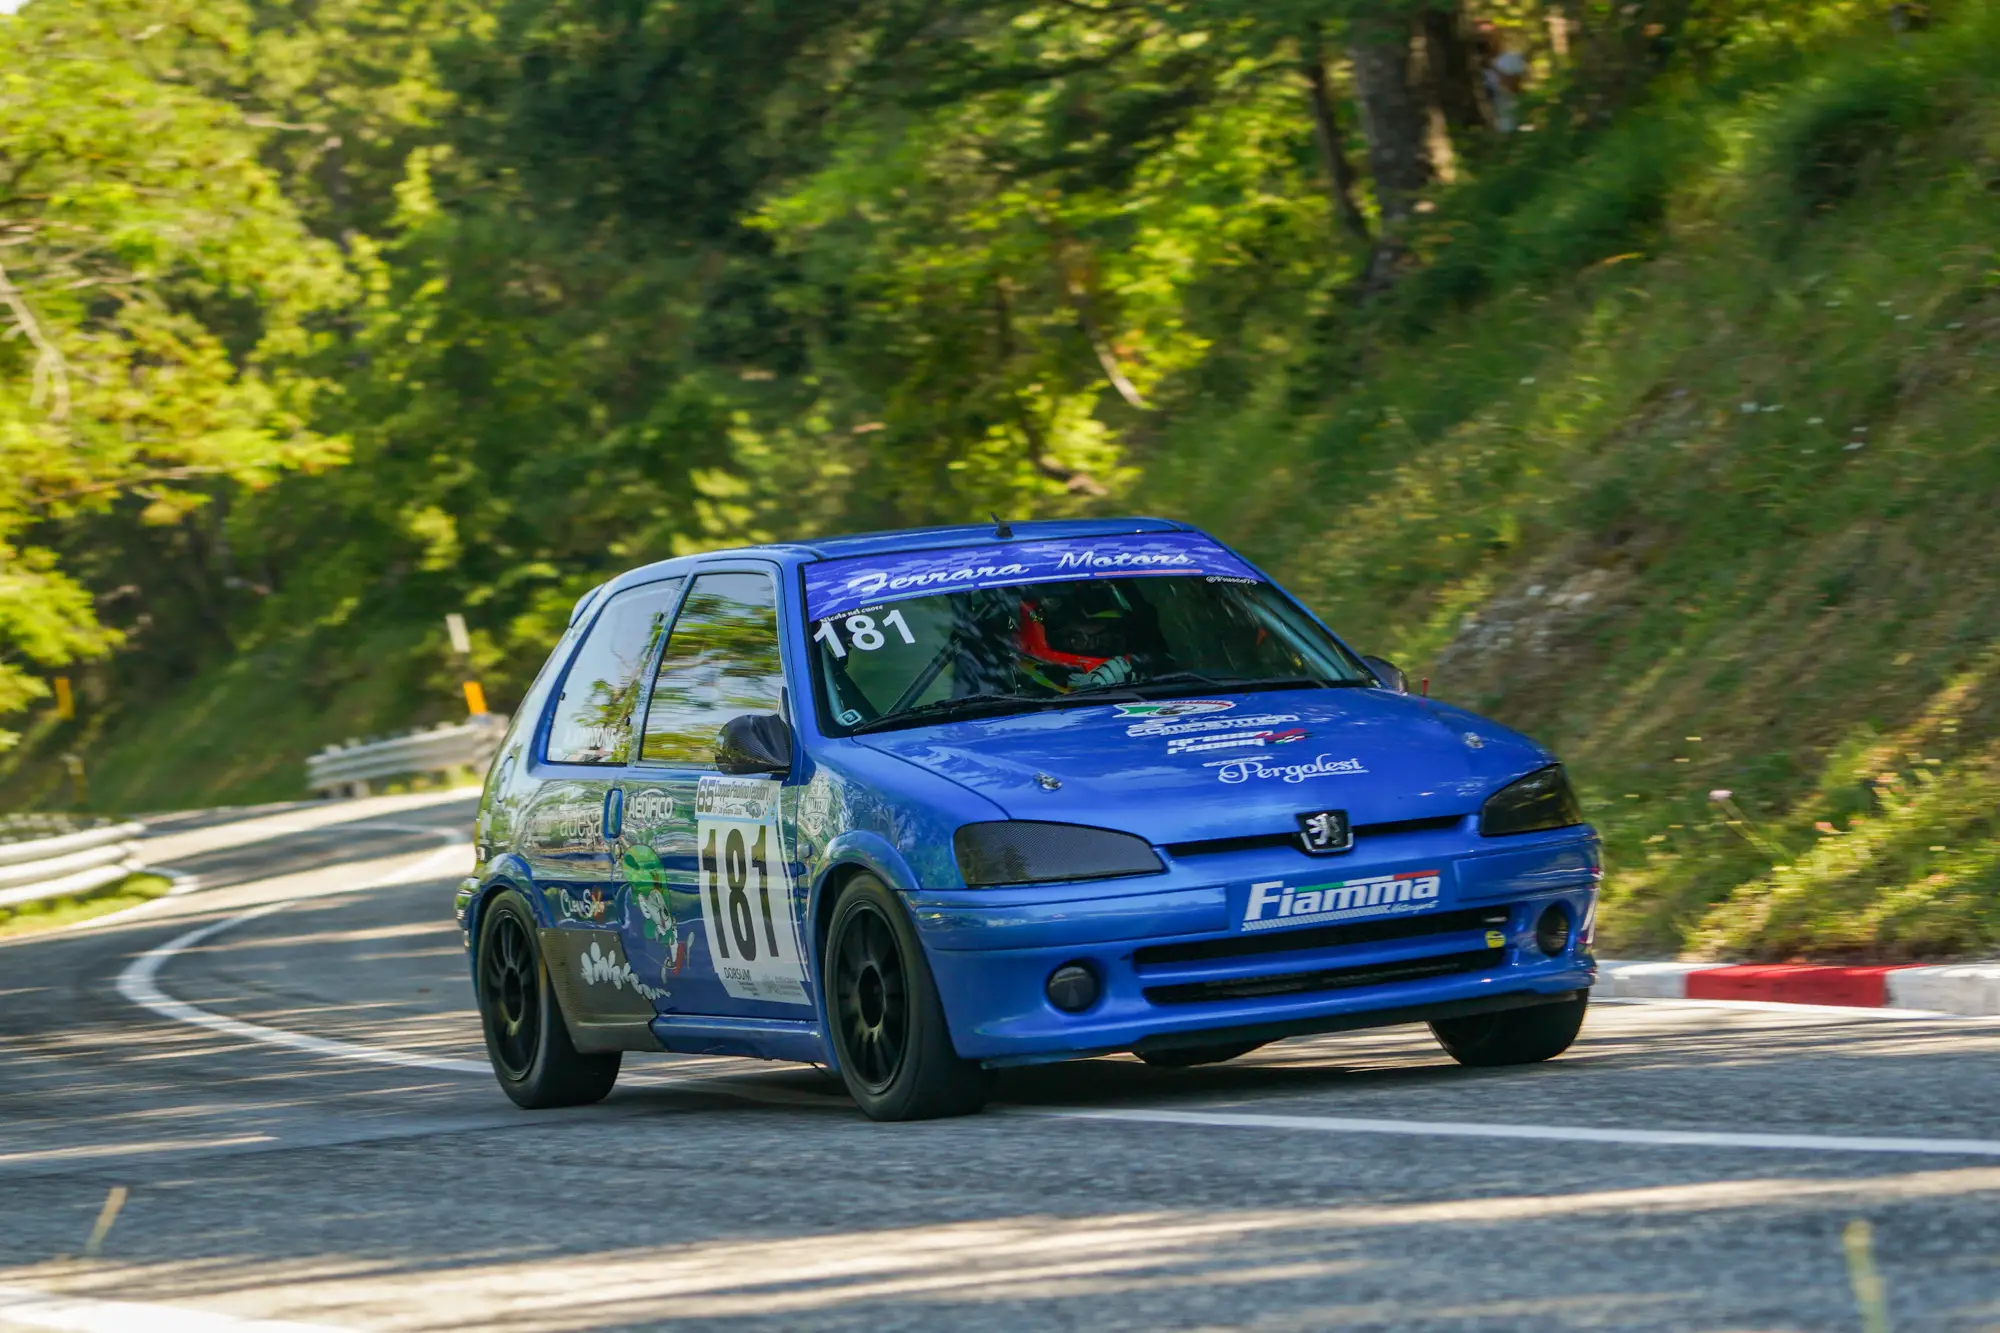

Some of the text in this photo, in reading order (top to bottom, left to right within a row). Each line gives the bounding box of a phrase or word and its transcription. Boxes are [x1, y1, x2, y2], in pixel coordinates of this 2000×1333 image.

[847, 562, 1030, 594] Ferrara
[820, 613, 847, 624] Nicola
[861, 604, 884, 613] cuore
[813, 609, 916, 659] 181
[1217, 753, 1368, 783] Pergolesi
[697, 779, 717, 812] 65
[701, 825, 779, 961] 181
[1243, 875, 1440, 921] Fiamma
[723, 967, 752, 981] DORSUM
